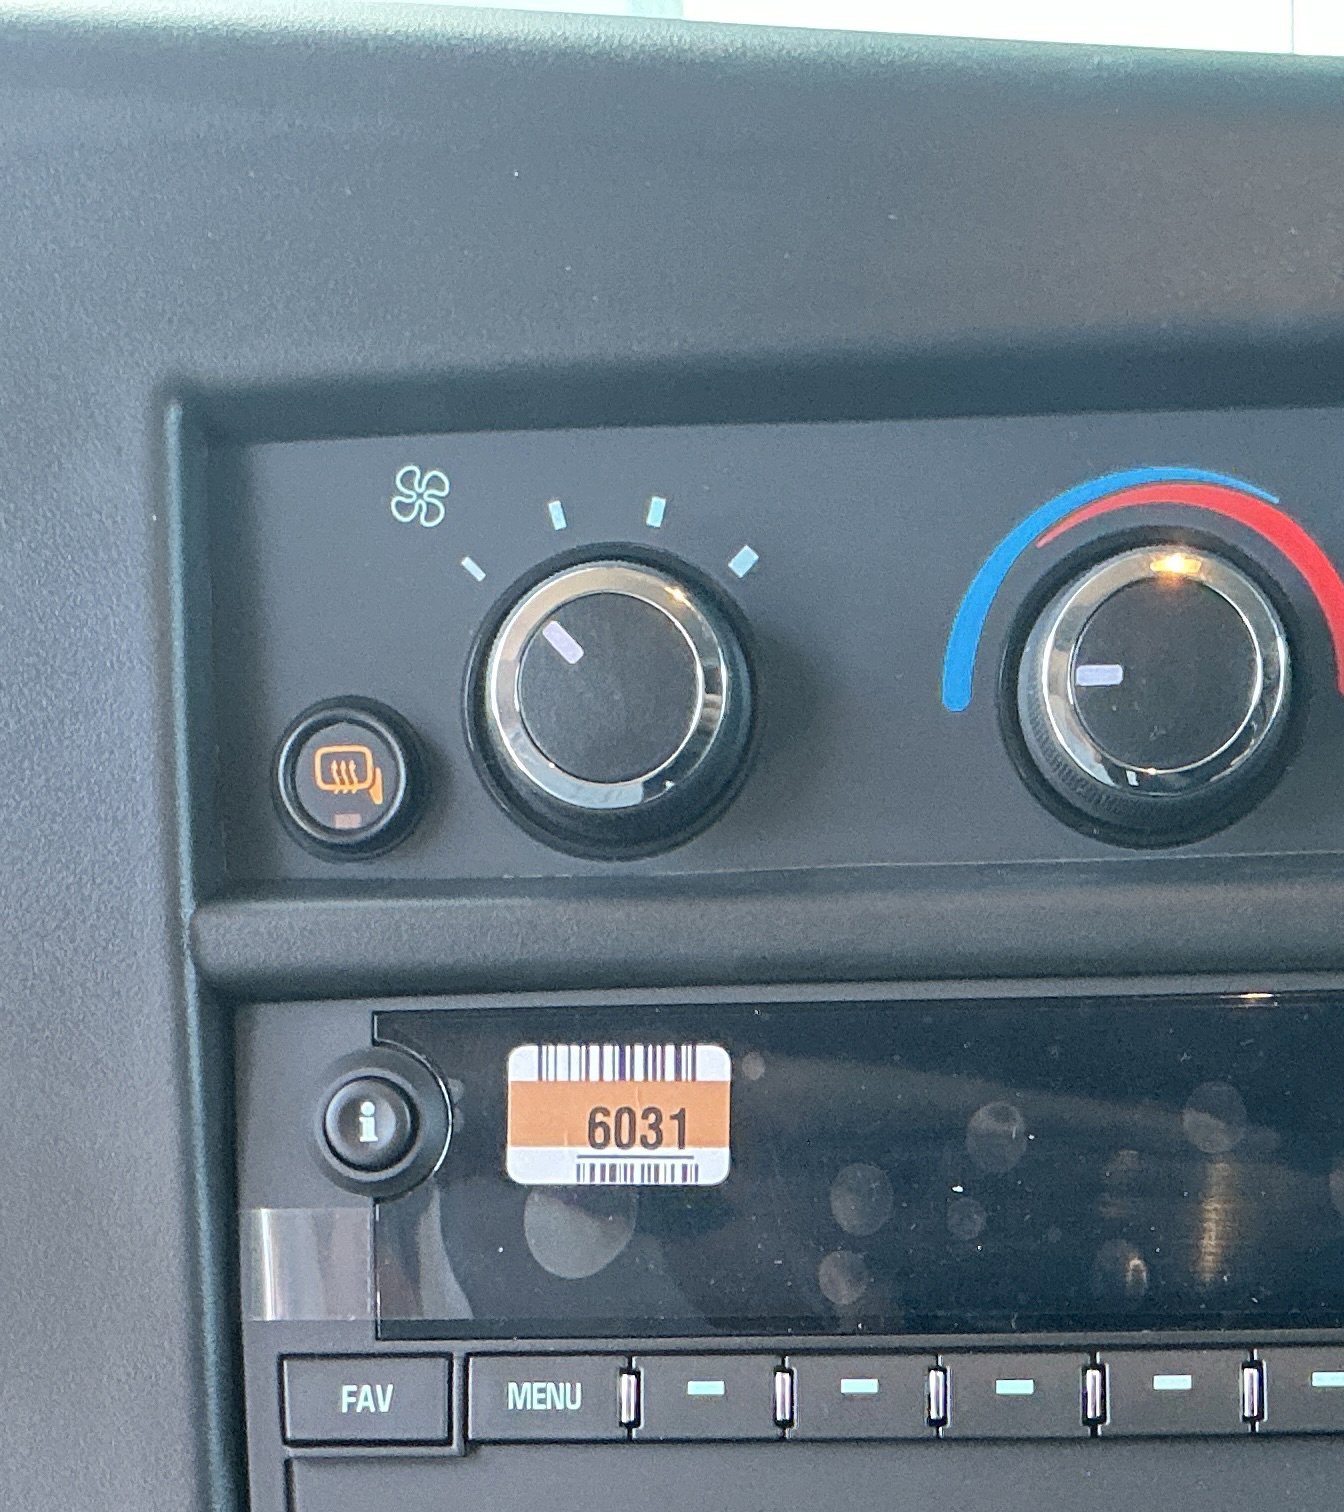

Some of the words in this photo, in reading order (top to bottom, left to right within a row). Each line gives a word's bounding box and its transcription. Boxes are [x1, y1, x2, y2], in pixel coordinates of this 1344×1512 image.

[588, 1107, 685, 1149] 6031
[342, 1384, 393, 1412] FAV
[508, 1382, 581, 1410] MENU
